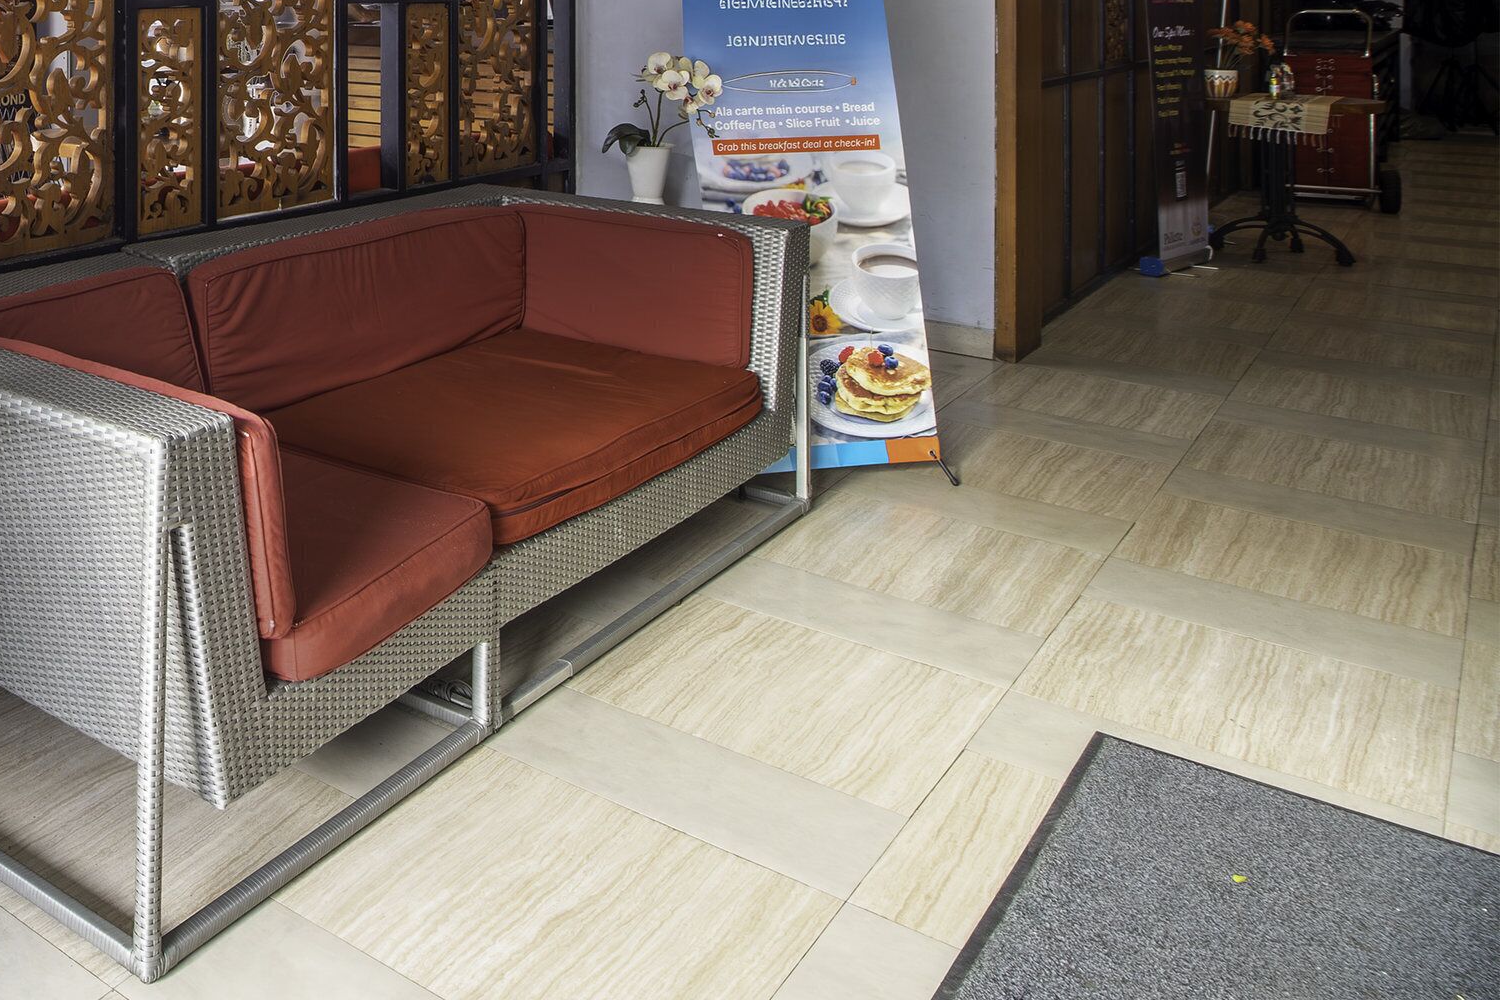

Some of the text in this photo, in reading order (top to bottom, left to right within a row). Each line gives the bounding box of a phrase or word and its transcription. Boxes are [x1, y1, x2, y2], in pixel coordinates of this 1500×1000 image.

[715, 101, 875, 117] Ala carte main course Bread
[714, 115, 881, 131] Coffee/Tea Slice Fruit Juice
[717, 138, 876, 152] Grab this breakfast deal at check-in!
